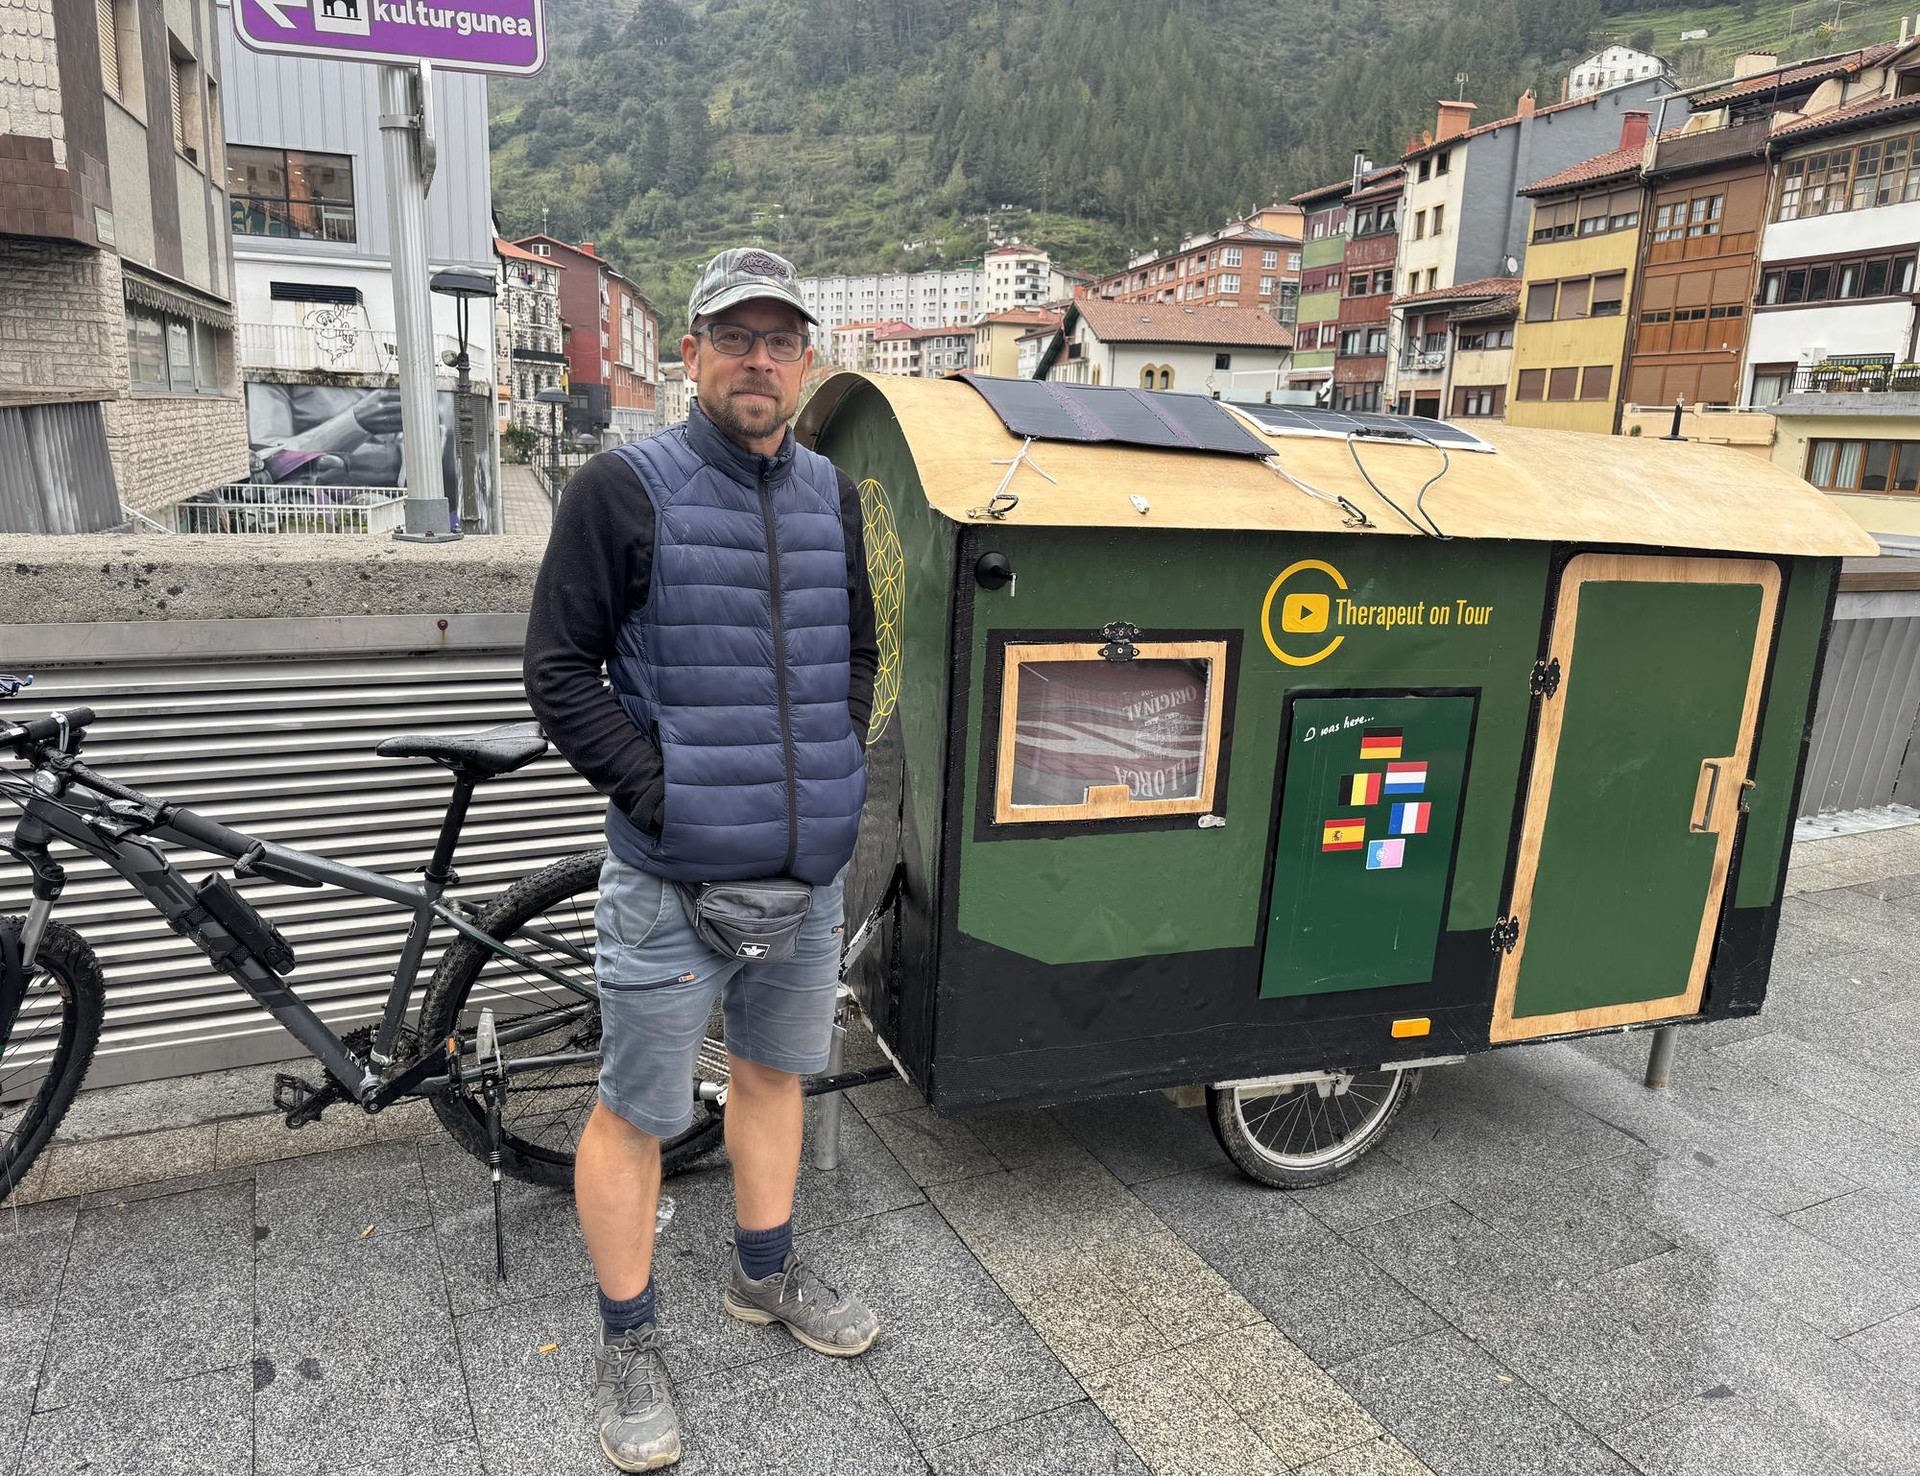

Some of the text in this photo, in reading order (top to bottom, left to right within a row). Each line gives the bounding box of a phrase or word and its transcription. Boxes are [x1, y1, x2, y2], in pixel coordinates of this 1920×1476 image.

[374, 0, 532, 37] kulturgunea
[1335, 598, 1494, 630] Therapeut on Tour
[1321, 724, 1340, 737] was
[1113, 759, 1190, 797] LLORCA
